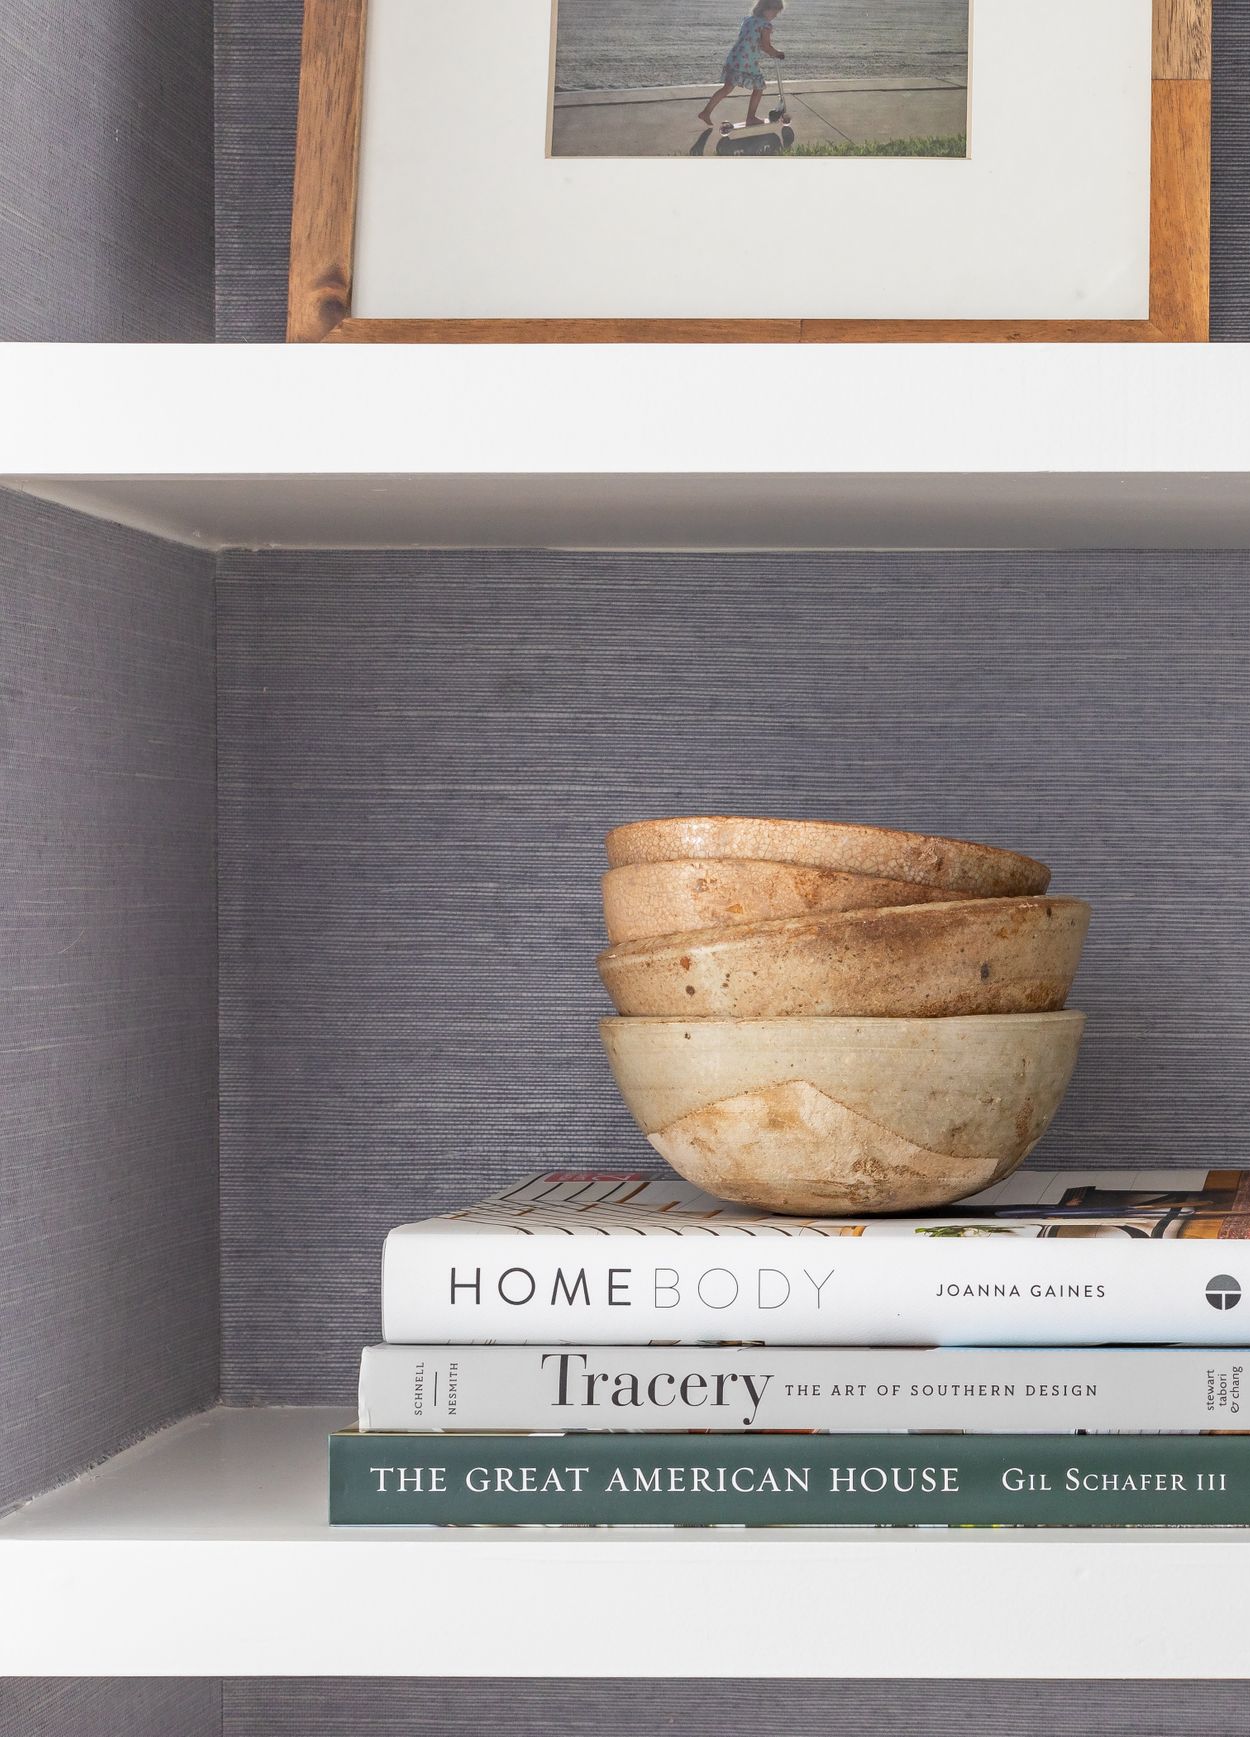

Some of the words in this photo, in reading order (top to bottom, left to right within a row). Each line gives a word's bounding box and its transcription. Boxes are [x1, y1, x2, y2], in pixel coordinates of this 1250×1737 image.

[450, 1267, 835, 1310] HOMEBODY
[936, 1283, 1021, 1297] JOANNA
[1030, 1284, 1105, 1298] GAINES
[414, 1362, 425, 1416] SCHNELL
[448, 1362, 459, 1415] NESMITH
[540, 1353, 775, 1426] Tracery
[784, 1384, 821, 1396] THE
[830, 1384, 867, 1396] ART
[876, 1384, 901, 1396] OF
[910, 1384, 1015, 1397] SOUTHERN
[1025, 1384, 1097, 1397] DESIGN
[1206, 1369, 1215, 1411] stewart
[1216, 1373, 1228, 1407] tabori
[1229, 1366, 1244, 1399] chang
[1230, 1401, 1240, 1414] &
[369, 1467, 447, 1492] THE
[465, 1467, 590, 1493] GREAT
[604, 1467, 811, 1493] AMERICAN
[829, 1467, 960, 1493] HOUSE
[1197, 1473, 1226, 1491] III
